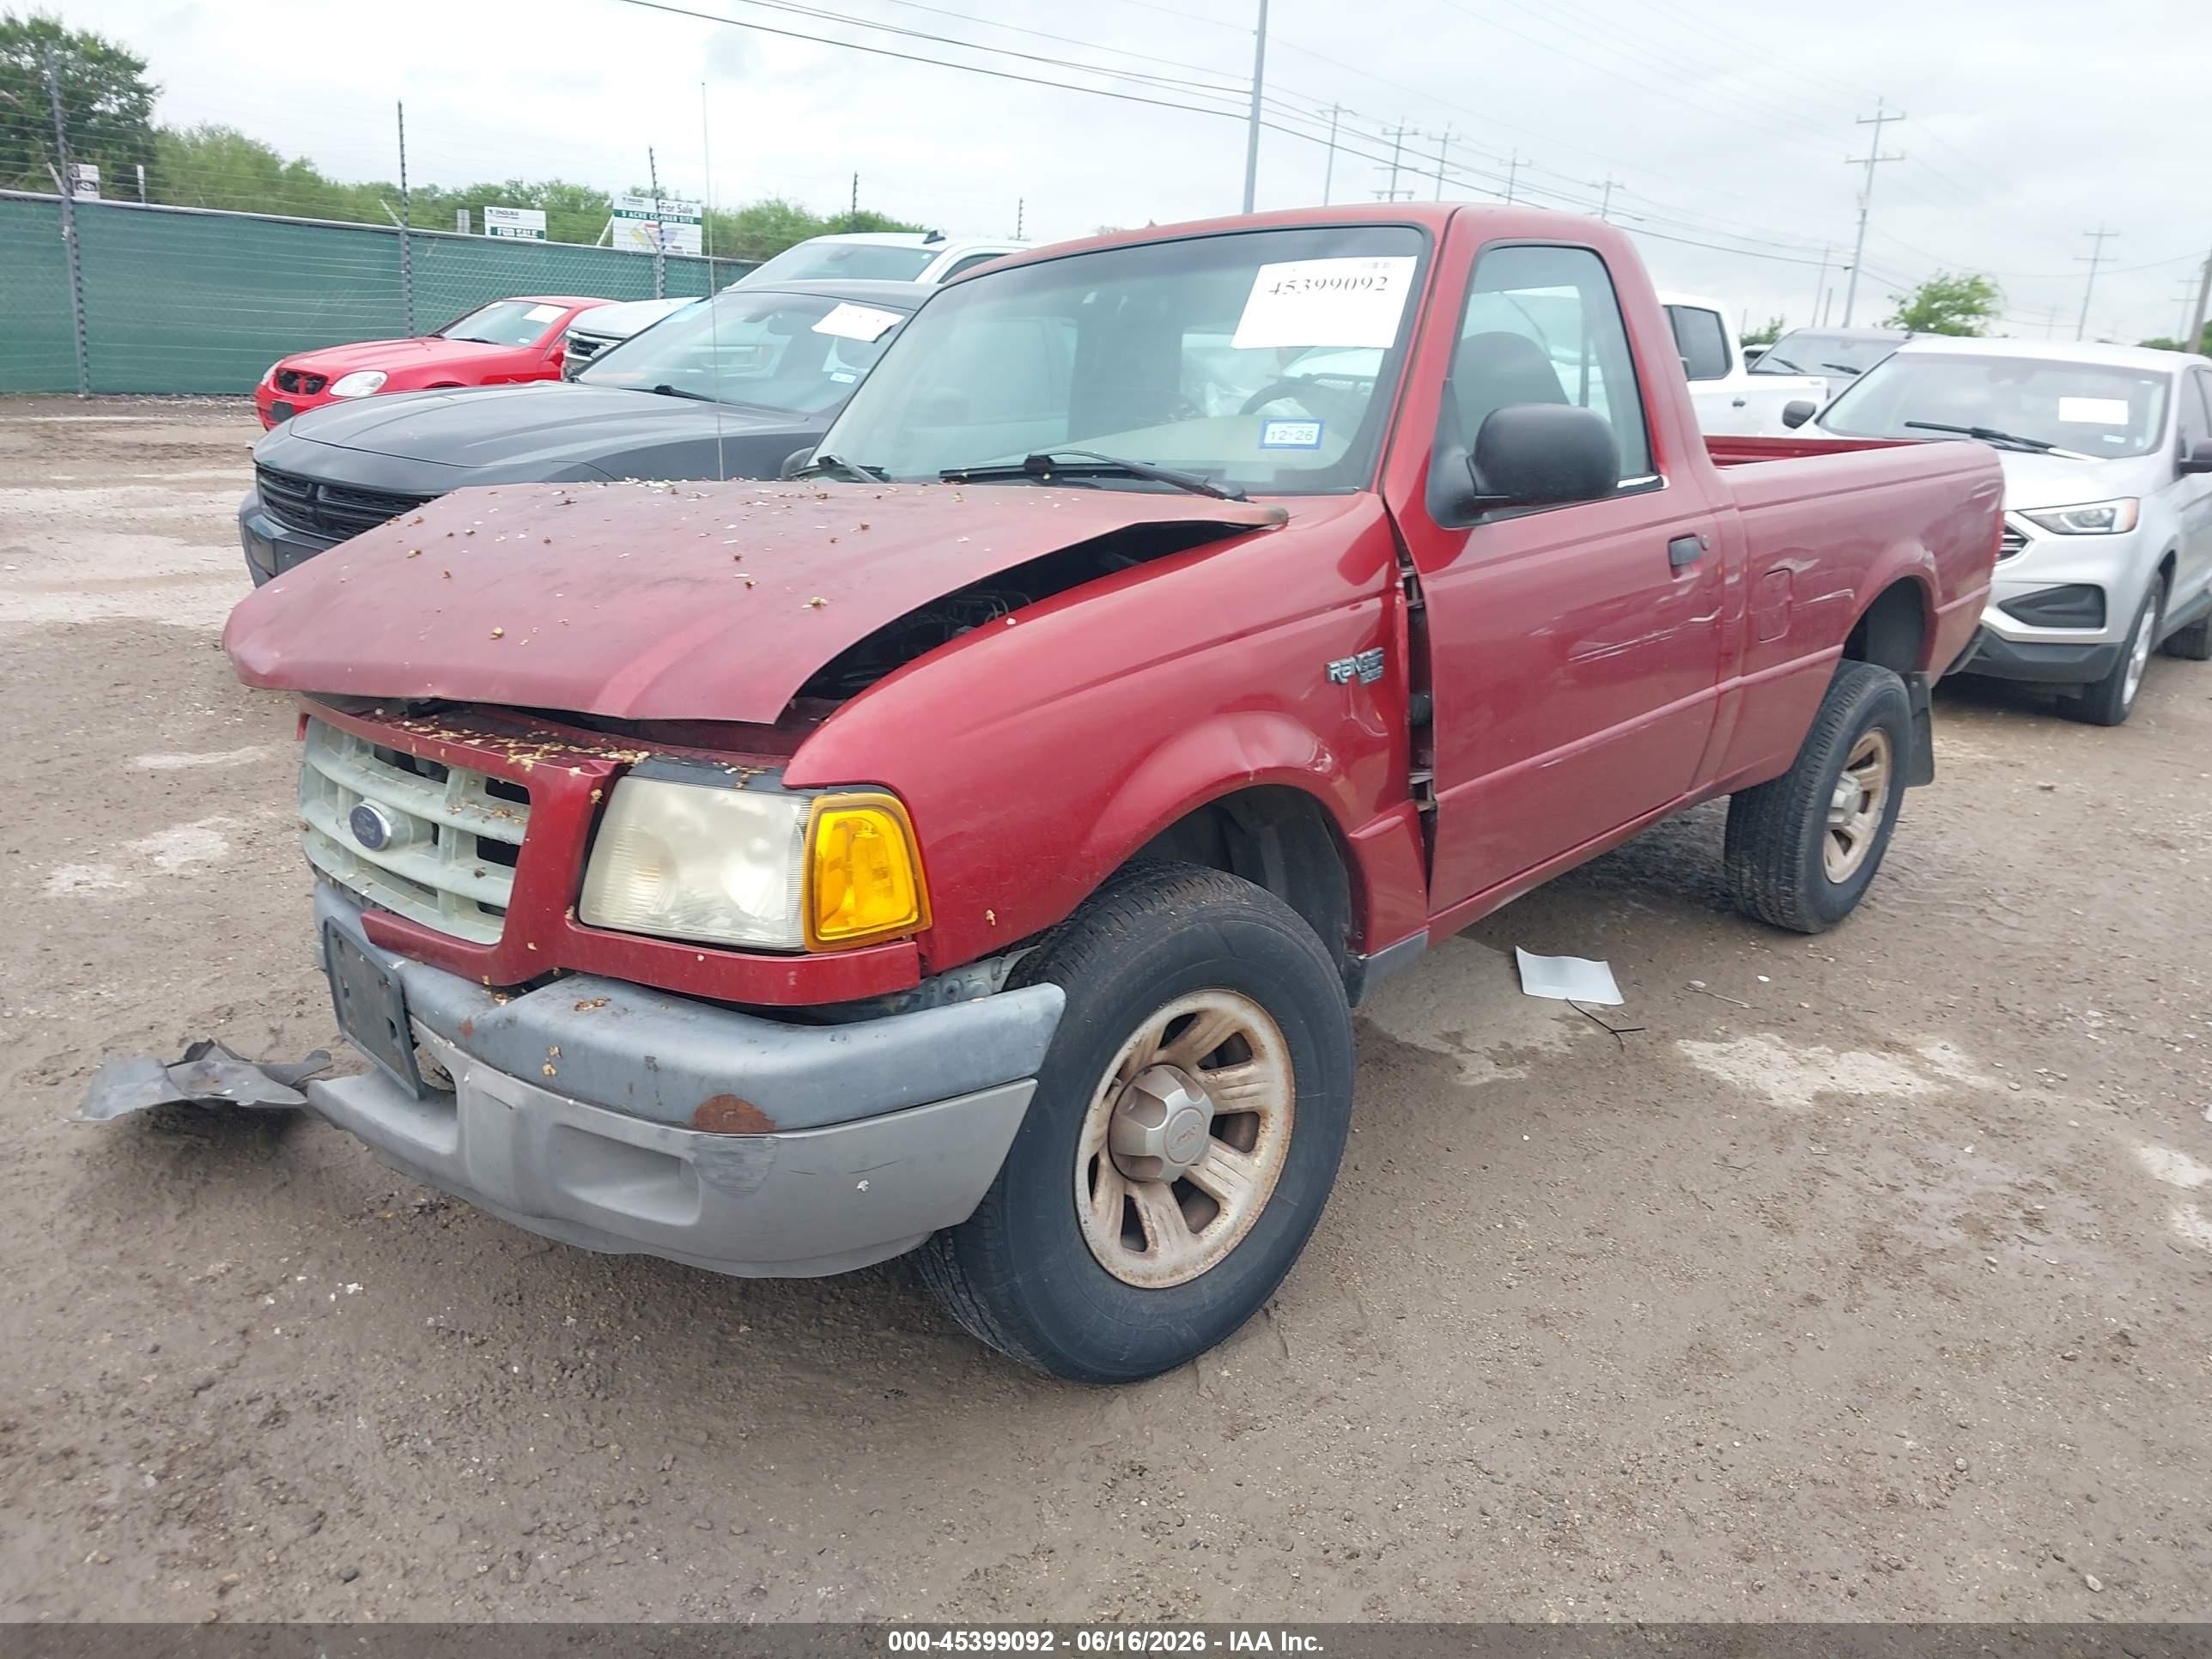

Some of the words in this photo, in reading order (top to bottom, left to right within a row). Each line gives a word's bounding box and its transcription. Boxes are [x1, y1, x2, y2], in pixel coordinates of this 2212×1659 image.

[659, 202, 675, 213] For
[677, 204, 694, 215] Sale
[628, 211, 647, 221] ACRE
[1268, 276, 1389, 295] 45399092
